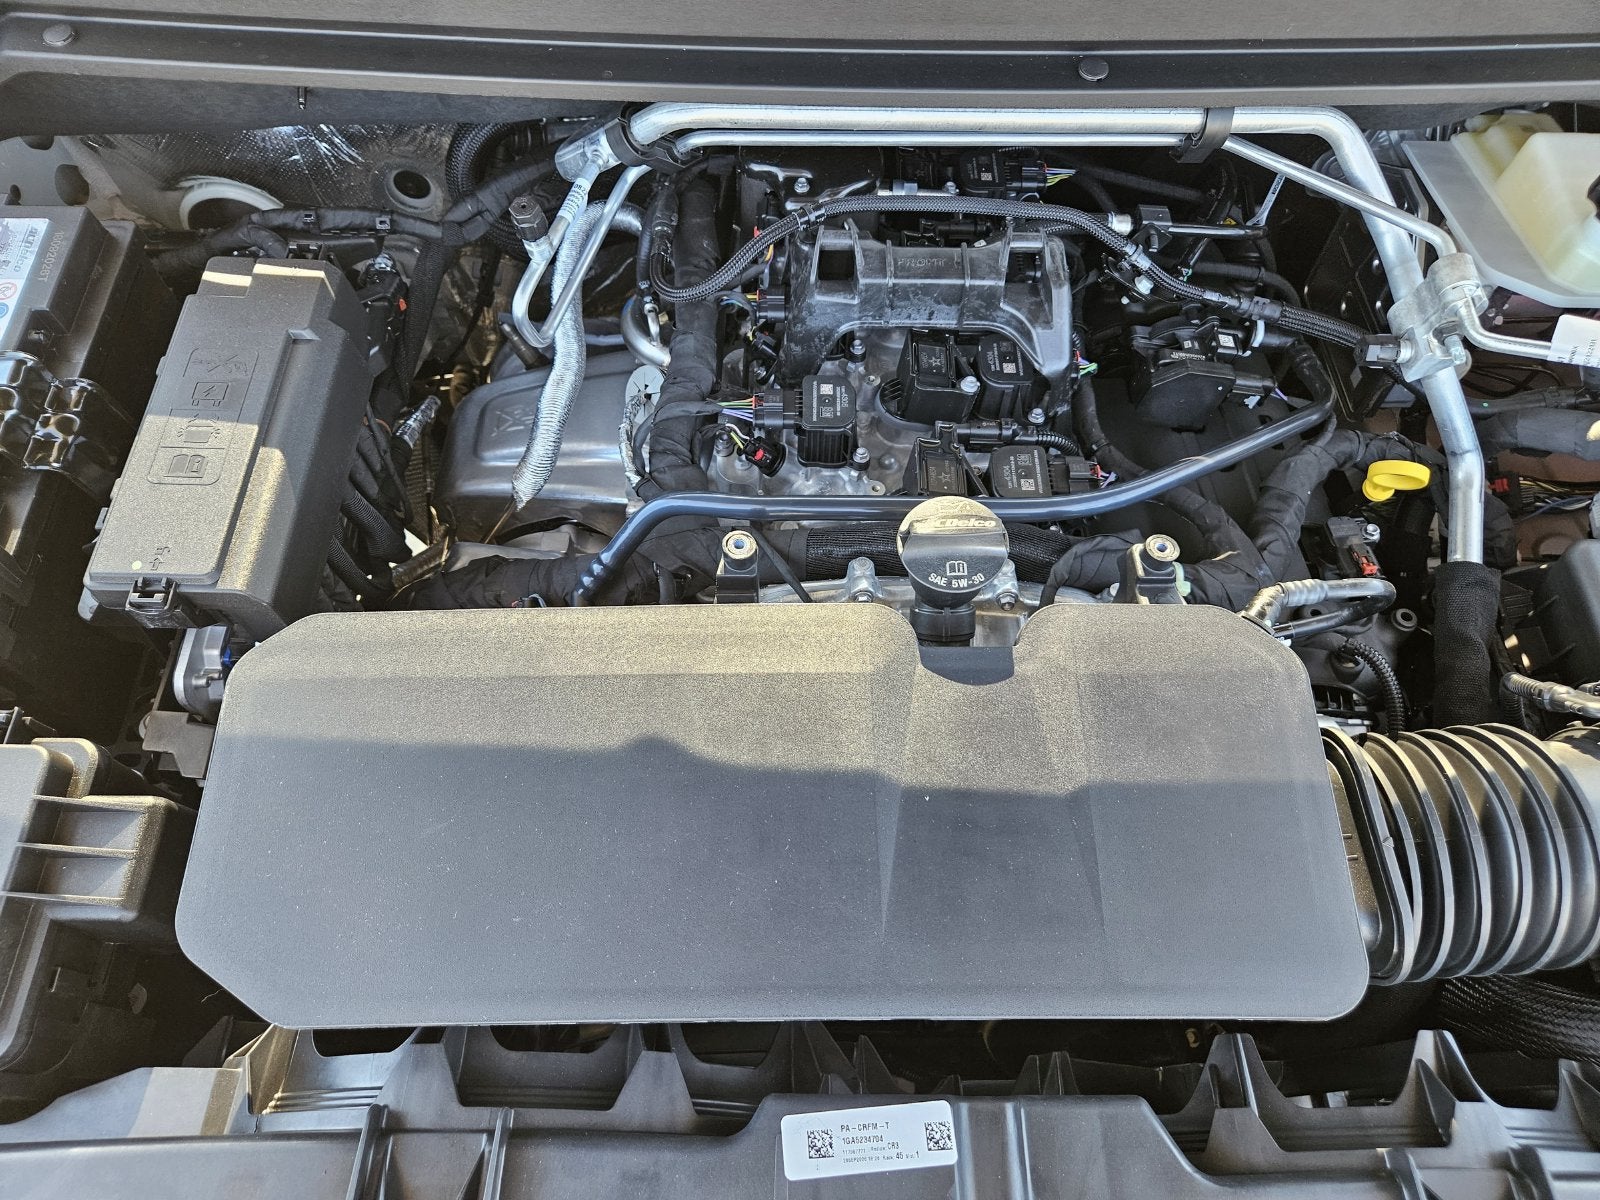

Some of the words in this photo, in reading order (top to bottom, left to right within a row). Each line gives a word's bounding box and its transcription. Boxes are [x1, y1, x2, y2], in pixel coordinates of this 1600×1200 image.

[928, 573, 948, 586] SAE
[951, 573, 985, 588] 5W-30
[887, 1141, 900, 1150] CR3
[895, 1151, 904, 1160] 45
